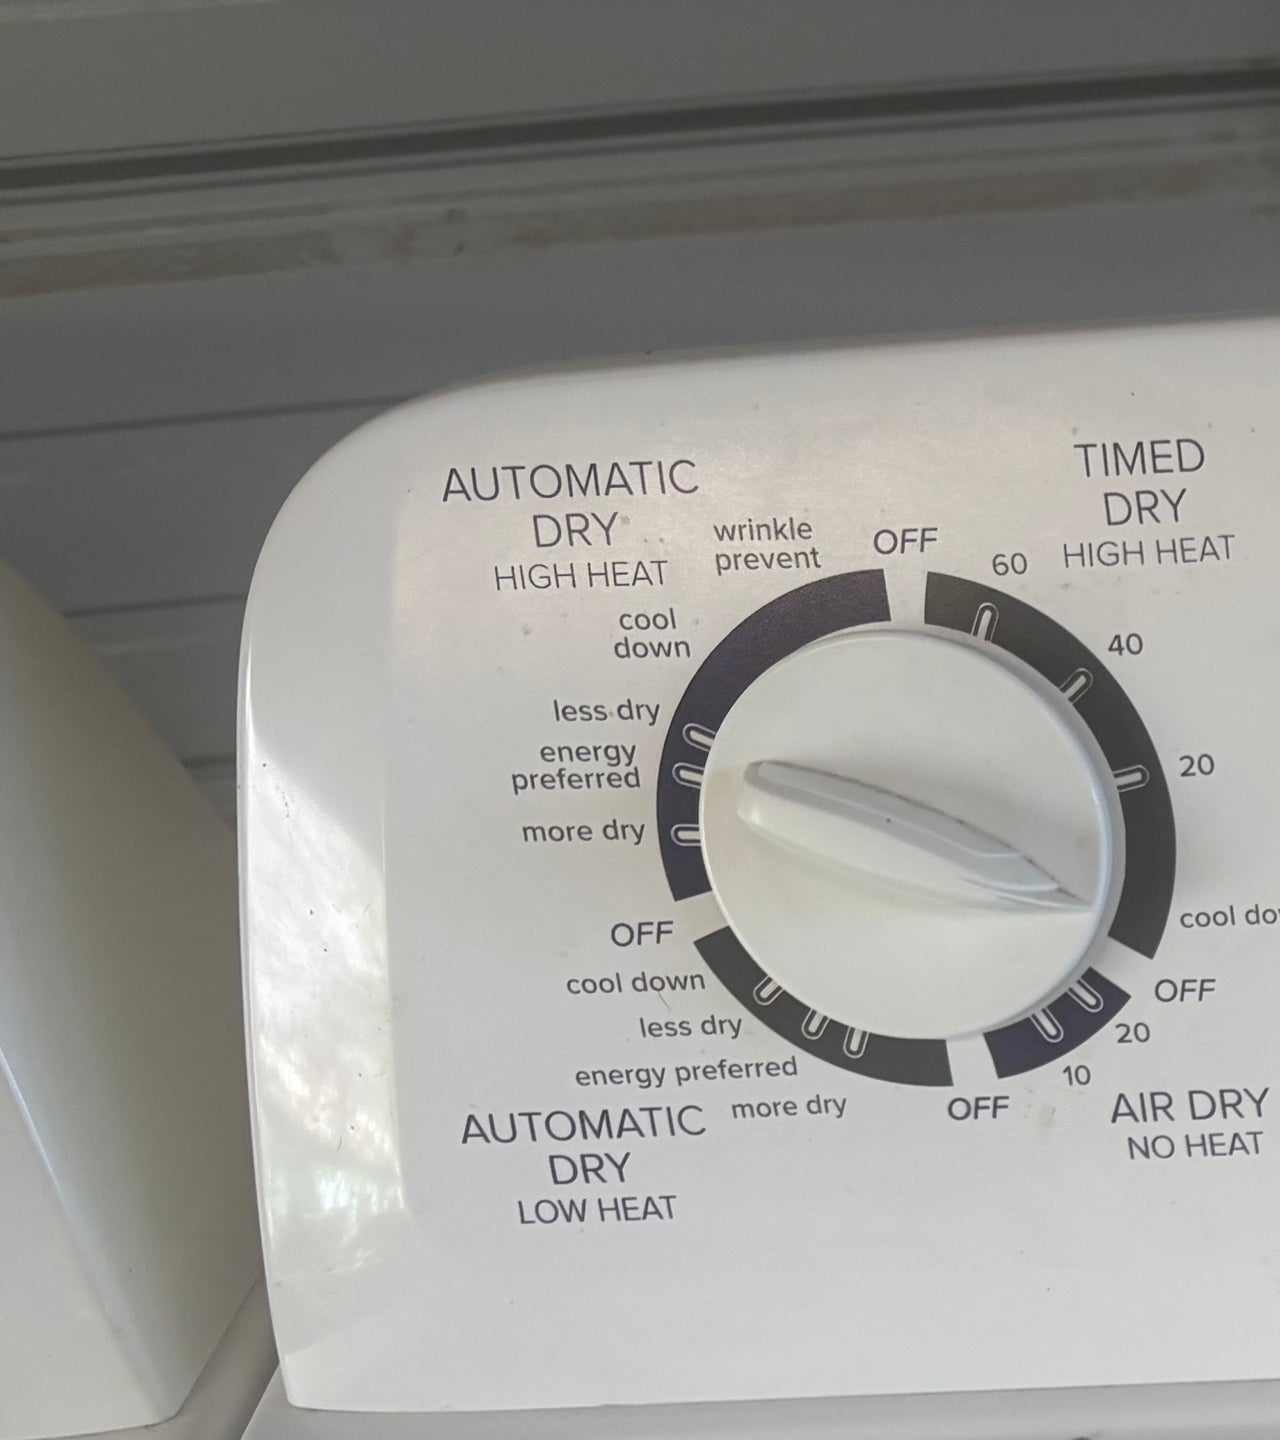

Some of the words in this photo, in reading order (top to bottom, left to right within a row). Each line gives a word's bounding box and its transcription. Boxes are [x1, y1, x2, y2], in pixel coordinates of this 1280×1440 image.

[1073, 438, 1205, 477] TIMED
[442, 459, 699, 502] AUTOMATIC
[1103, 488, 1187, 526] DRY
[532, 512, 618, 548] DRY
[713, 518, 813, 542] wrinkle
[873, 527, 938, 555] OFF
[715, 547, 821, 576] prevent
[991, 552, 1028, 576] 60
[1063, 541, 1144, 568] HIGH
[1156, 535, 1236, 564] HEAT
[495, 563, 576, 591] HIGH
[588, 560, 668, 587] HEAT
[619, 608, 677, 630] cool
[614, 636, 691, 659] down
[1107, 633, 1143, 657] 40
[553, 700, 608, 722] less
[616, 699, 661, 726] dry
[539, 742, 637, 766] energy
[1179, 754, 1215, 777] 20
[511, 767, 641, 795] preferred
[522, 822, 593, 842] more
[602, 819, 646, 846] dry
[1180, 905, 1236, 929] cool
[610, 920, 674, 948] OFF
[566, 973, 622, 995] cool
[632, 972, 706, 993] down
[1154, 979, 1216, 1003] OFF
[639, 1017, 693, 1038] less
[700, 1014, 743, 1039] dry
[1115, 1022, 1151, 1044] 20
[575, 1065, 666, 1089] energy
[675, 1056, 798, 1088] preferred
[1062, 1064, 1091, 1086] 10
[731, 1098, 798, 1120] more
[806, 1094, 847, 1118] dry
[947, 1096, 1010, 1121] OFF
[1110, 1091, 1175, 1124] AIR
[1188, 1087, 1270, 1121] DRY
[461, 1105, 707, 1145] AUTOMATIC
[1127, 1135, 1175, 1160] NO
[1185, 1131, 1264, 1157] HEAT
[549, 1152, 631, 1185] DRY
[518, 1198, 587, 1224] LOW
[599, 1195, 677, 1222] HEAT
